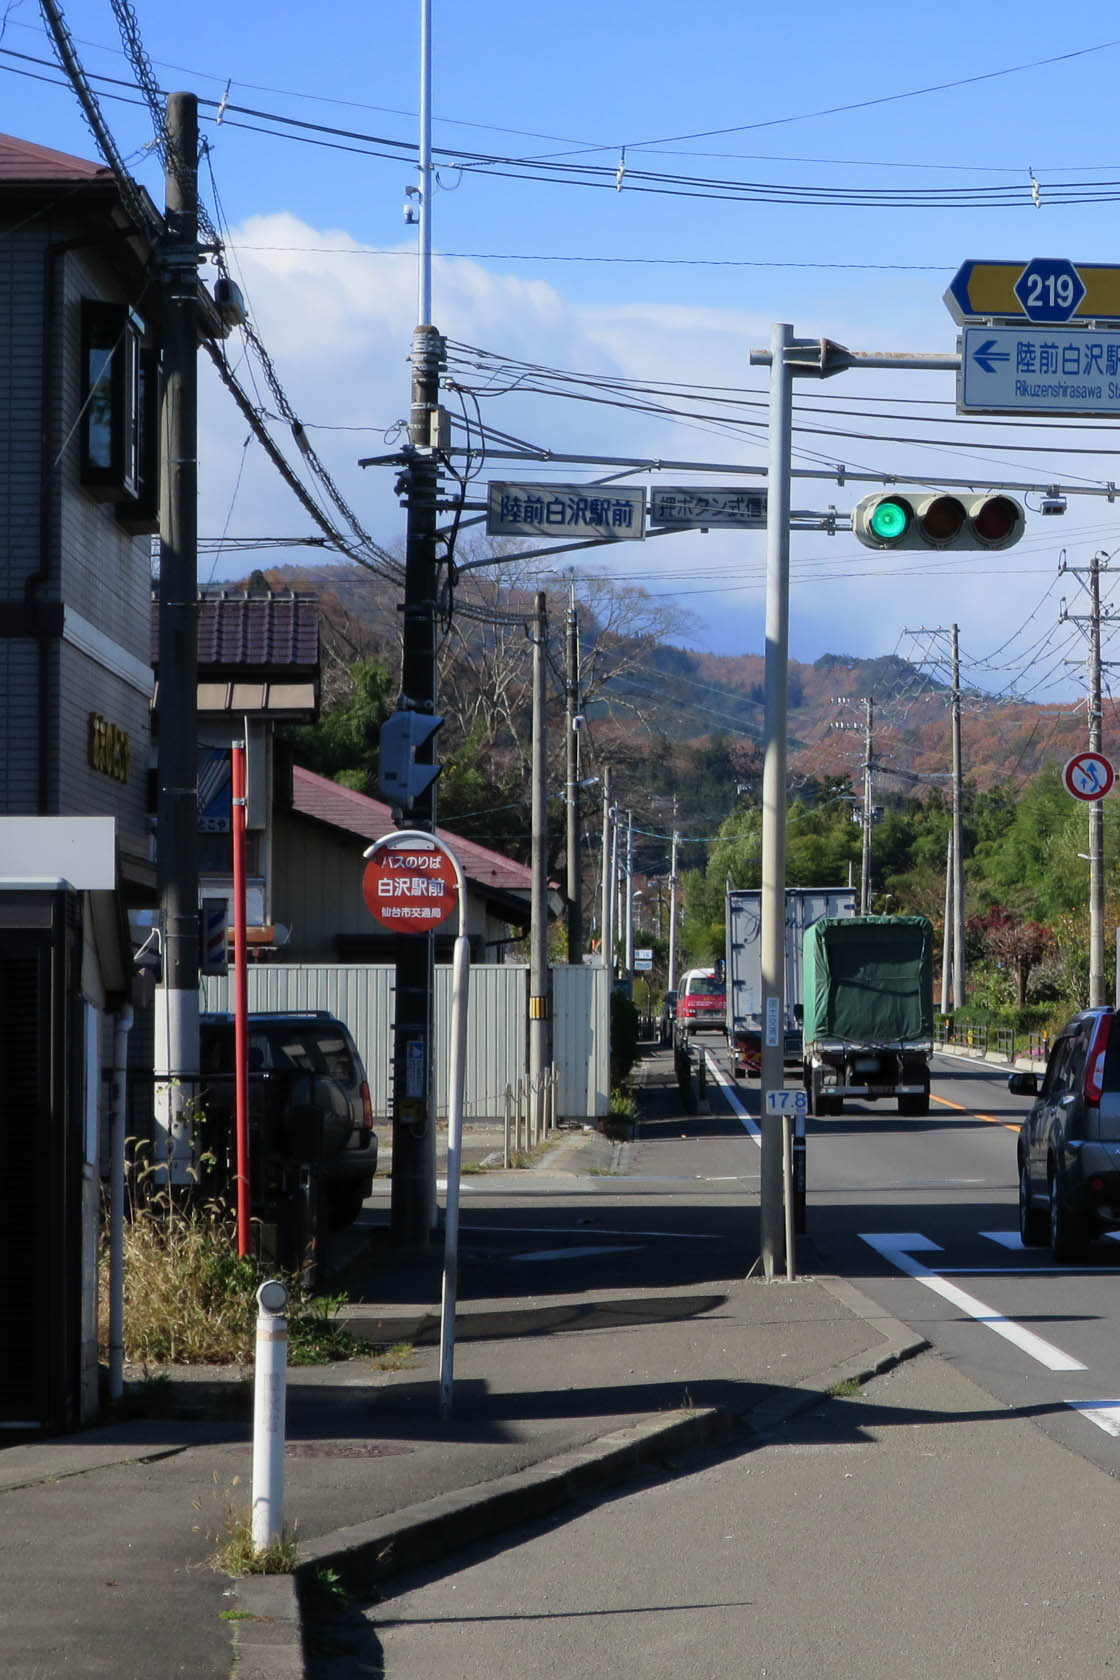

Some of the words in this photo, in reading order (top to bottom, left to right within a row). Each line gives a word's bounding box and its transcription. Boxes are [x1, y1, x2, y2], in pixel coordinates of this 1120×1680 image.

[1027, 273, 1074, 308] 219
[1015, 379, 1103, 399] Rikuzenshirasawa
[500, 495, 634, 528] 陸前白沢駅前
[659, 496, 768, 518] 押ボタン式信
[381, 856, 442, 869] バスのりば
[378, 878, 445, 896] 白沢駅前
[381, 907, 442, 918] 仙台市交通局
[768, 1092, 806, 1109] 17.8
